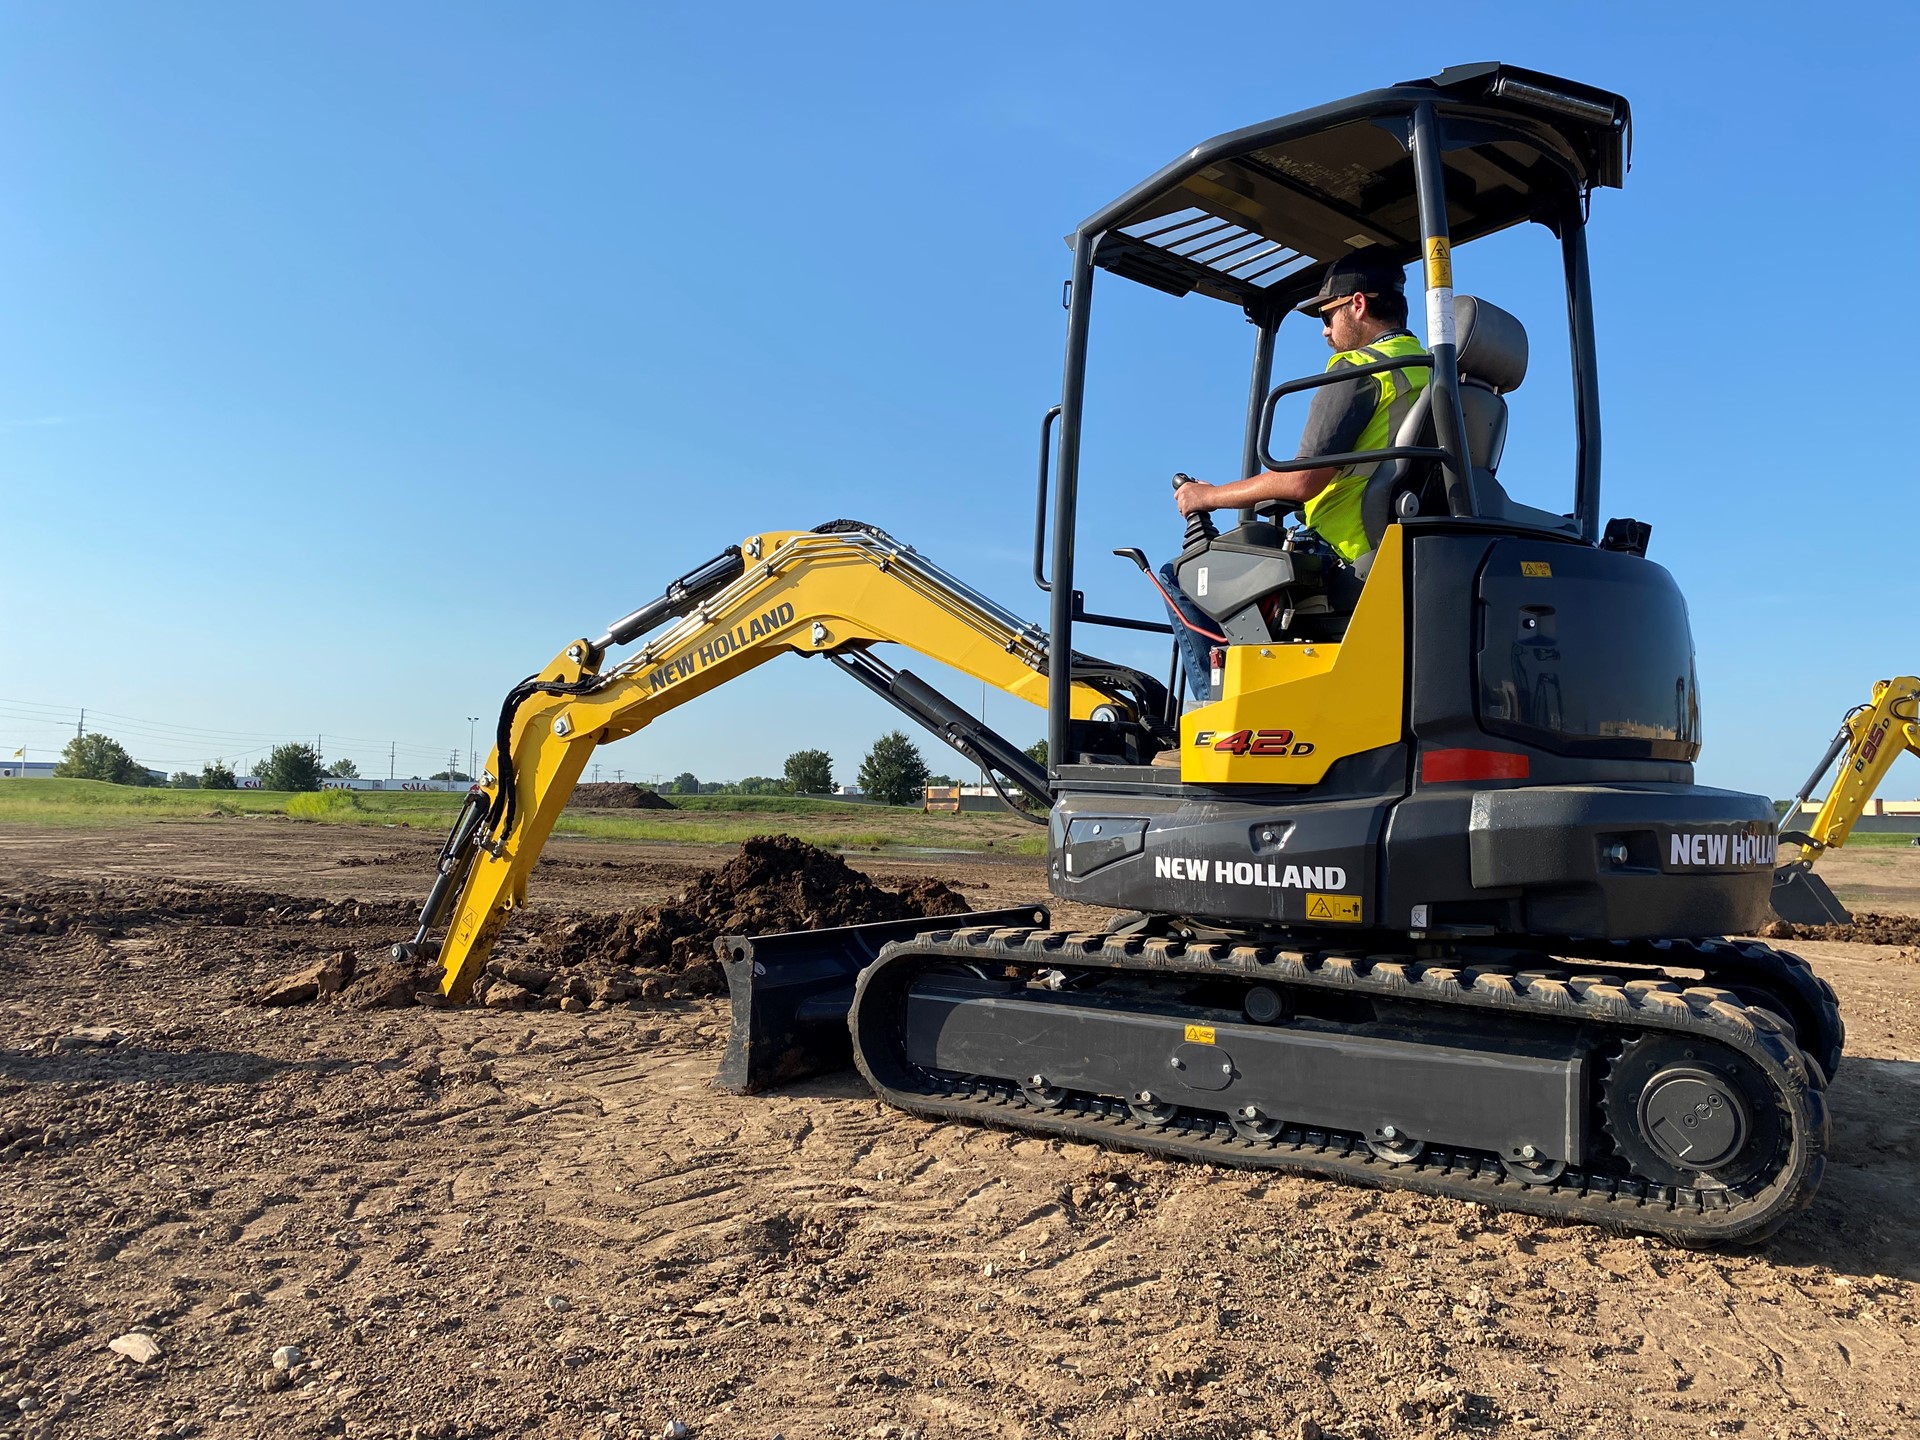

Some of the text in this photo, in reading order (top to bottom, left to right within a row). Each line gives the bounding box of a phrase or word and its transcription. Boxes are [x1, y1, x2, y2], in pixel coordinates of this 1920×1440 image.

[649, 602, 795, 692] NEW HOLLAND
[1194, 729, 1316, 756] E42D
[244, 780, 262, 788] SAI
[1670, 833, 1728, 865] NEW
[1155, 856, 1347, 890] NEW HOLLAND
